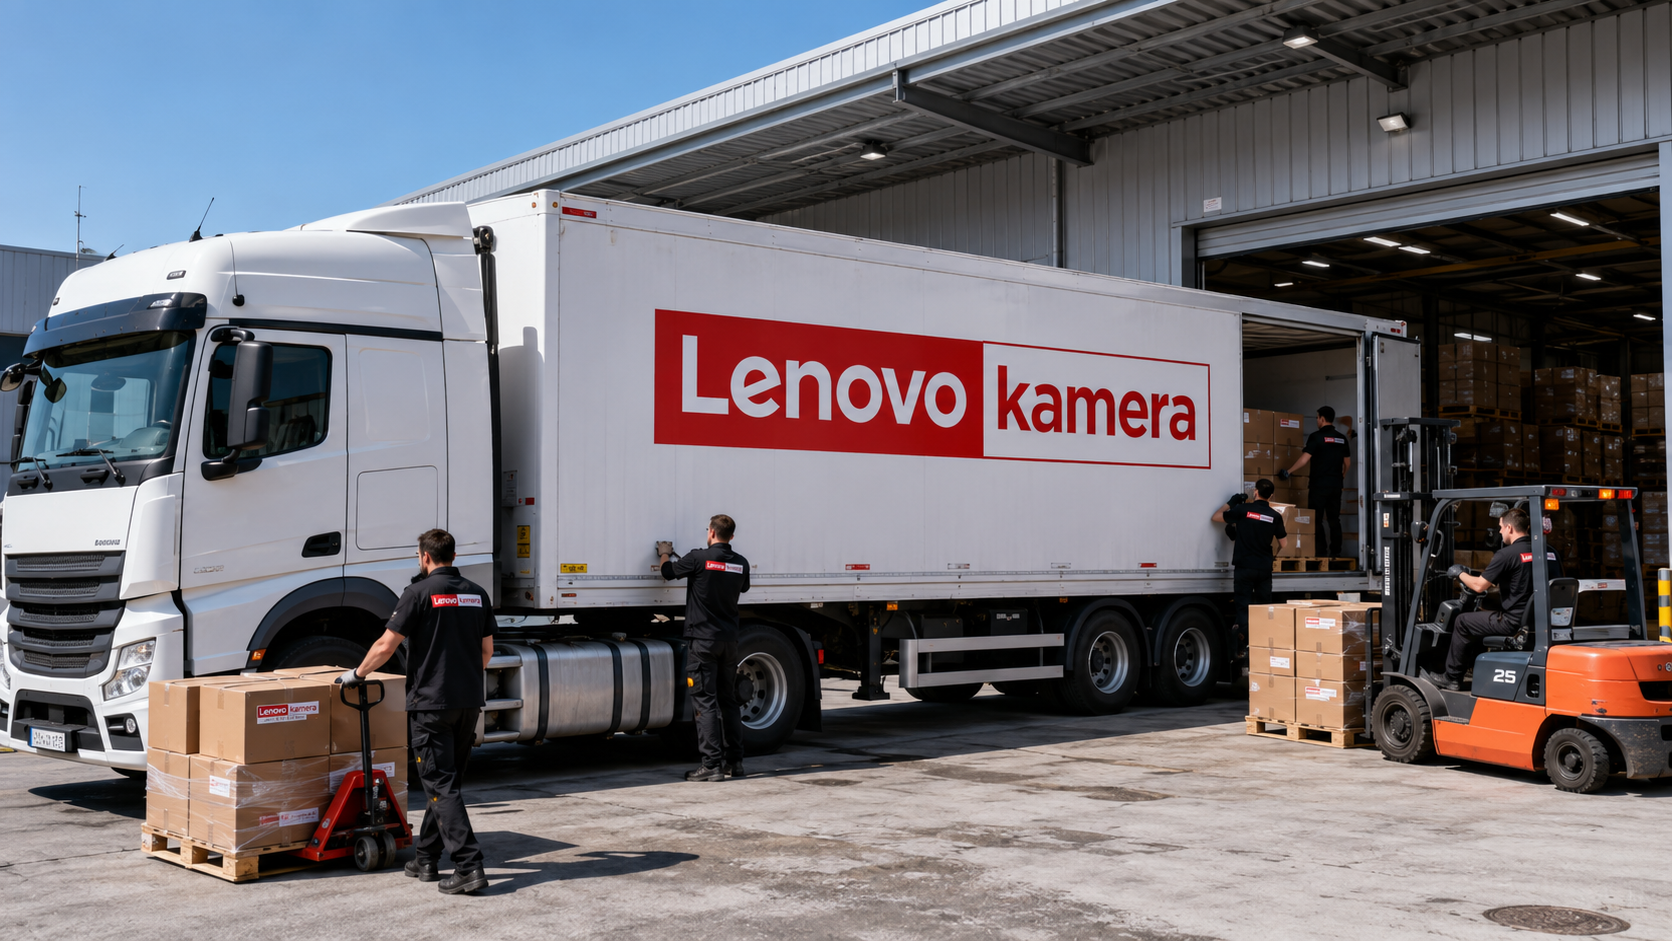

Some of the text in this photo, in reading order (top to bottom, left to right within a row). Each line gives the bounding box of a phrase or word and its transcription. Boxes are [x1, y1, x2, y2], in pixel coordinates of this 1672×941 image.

[682, 334, 1196, 441] Lenovo kamera
[1493, 668, 1516, 684] 25
